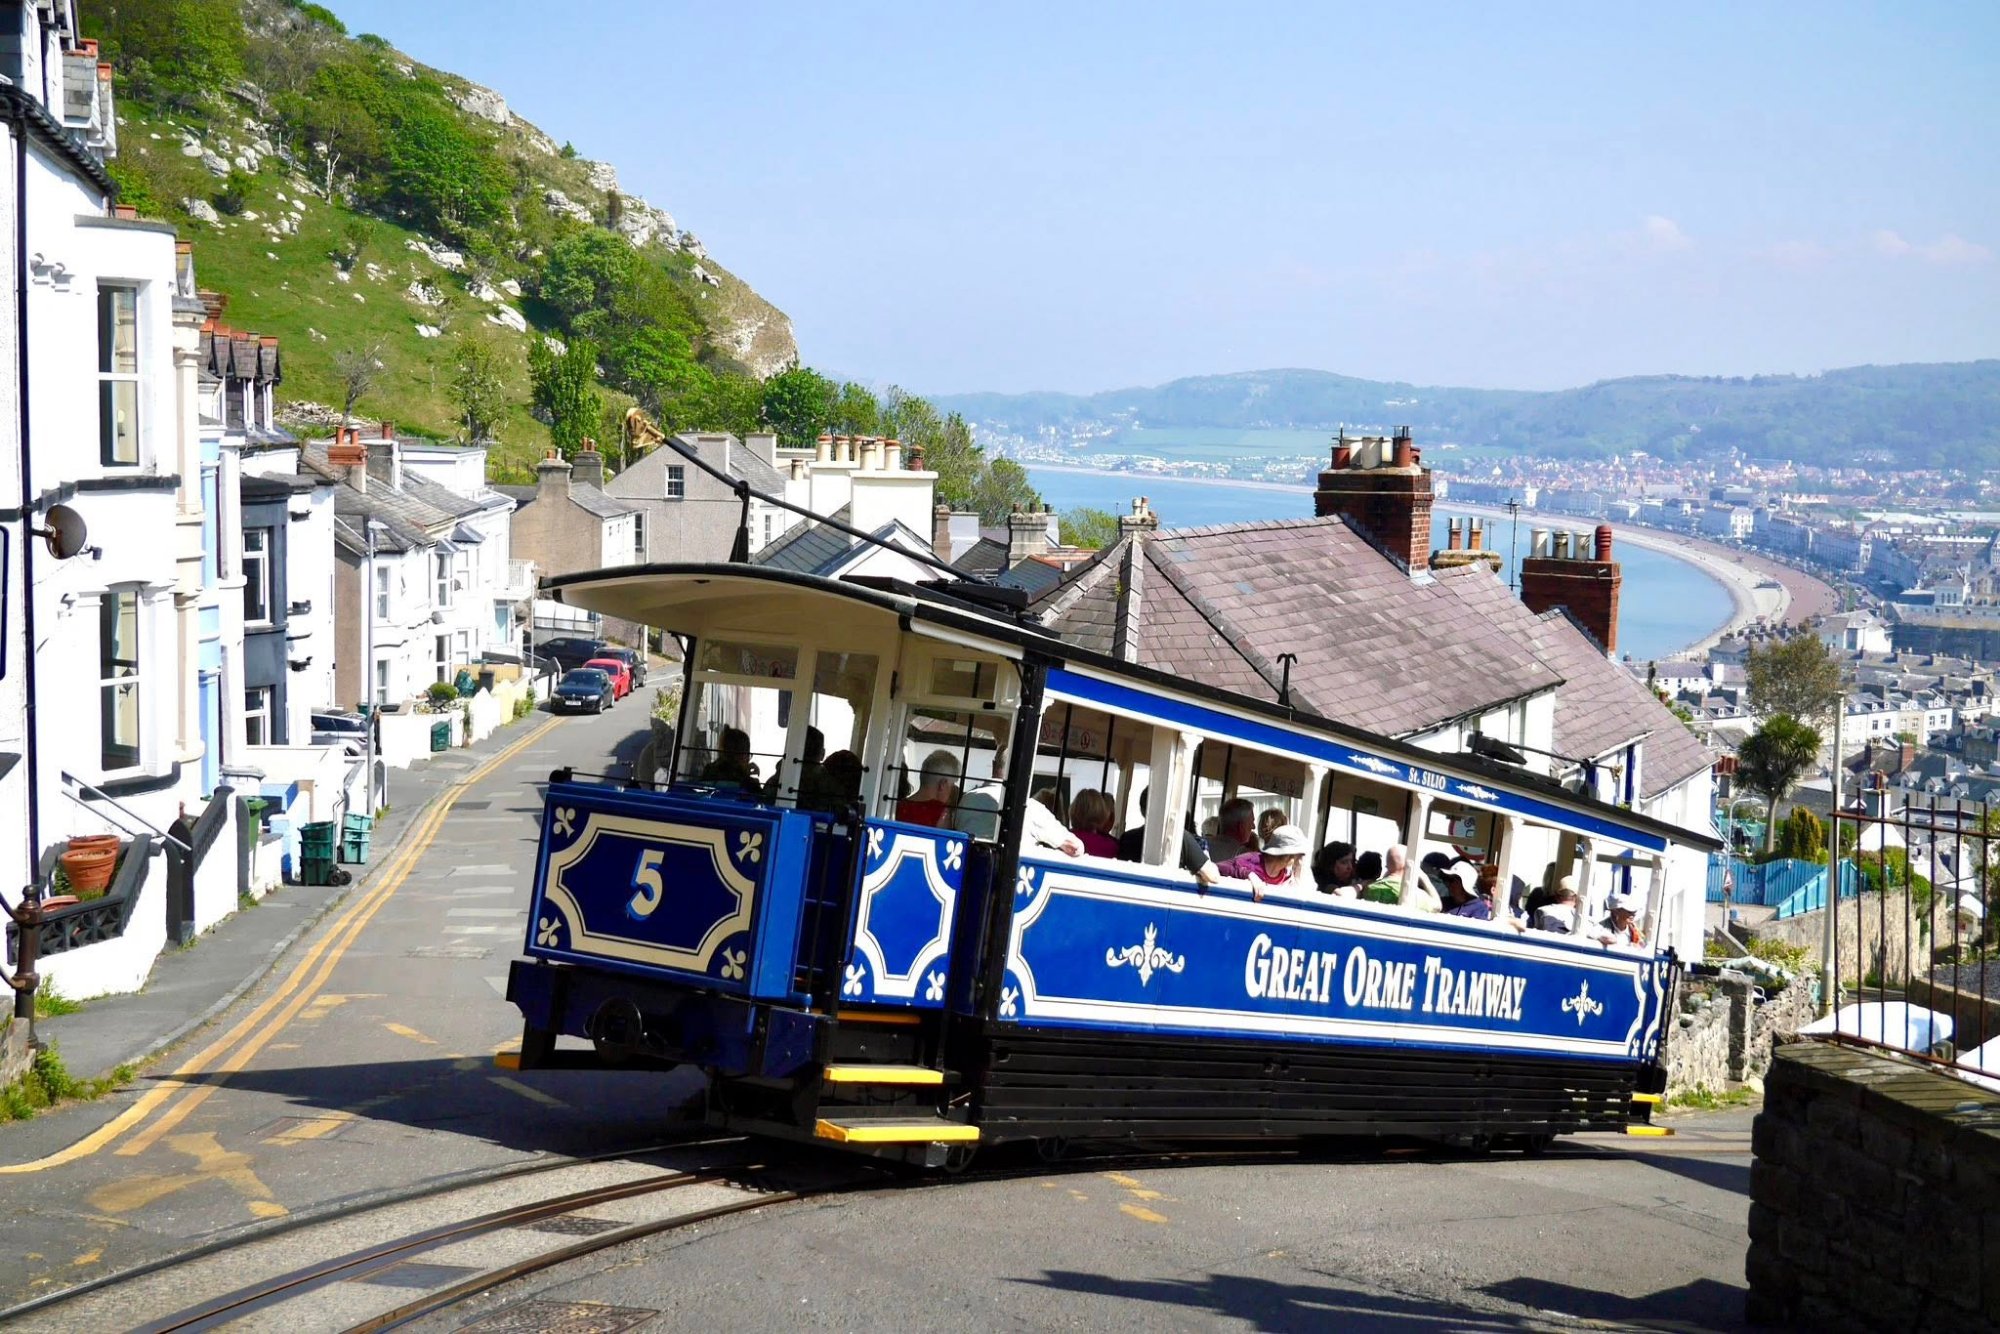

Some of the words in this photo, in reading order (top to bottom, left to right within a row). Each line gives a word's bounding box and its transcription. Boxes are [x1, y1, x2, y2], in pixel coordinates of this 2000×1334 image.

[1407, 766, 1420, 784] St.
[1421, 769, 1447, 789] SILIO
[629, 848, 665, 916] 5
[1244, 932, 1337, 1004] GREAT
[1343, 945, 1417, 1011] ORME
[1421, 954, 1528, 1022] TRAMWAY
